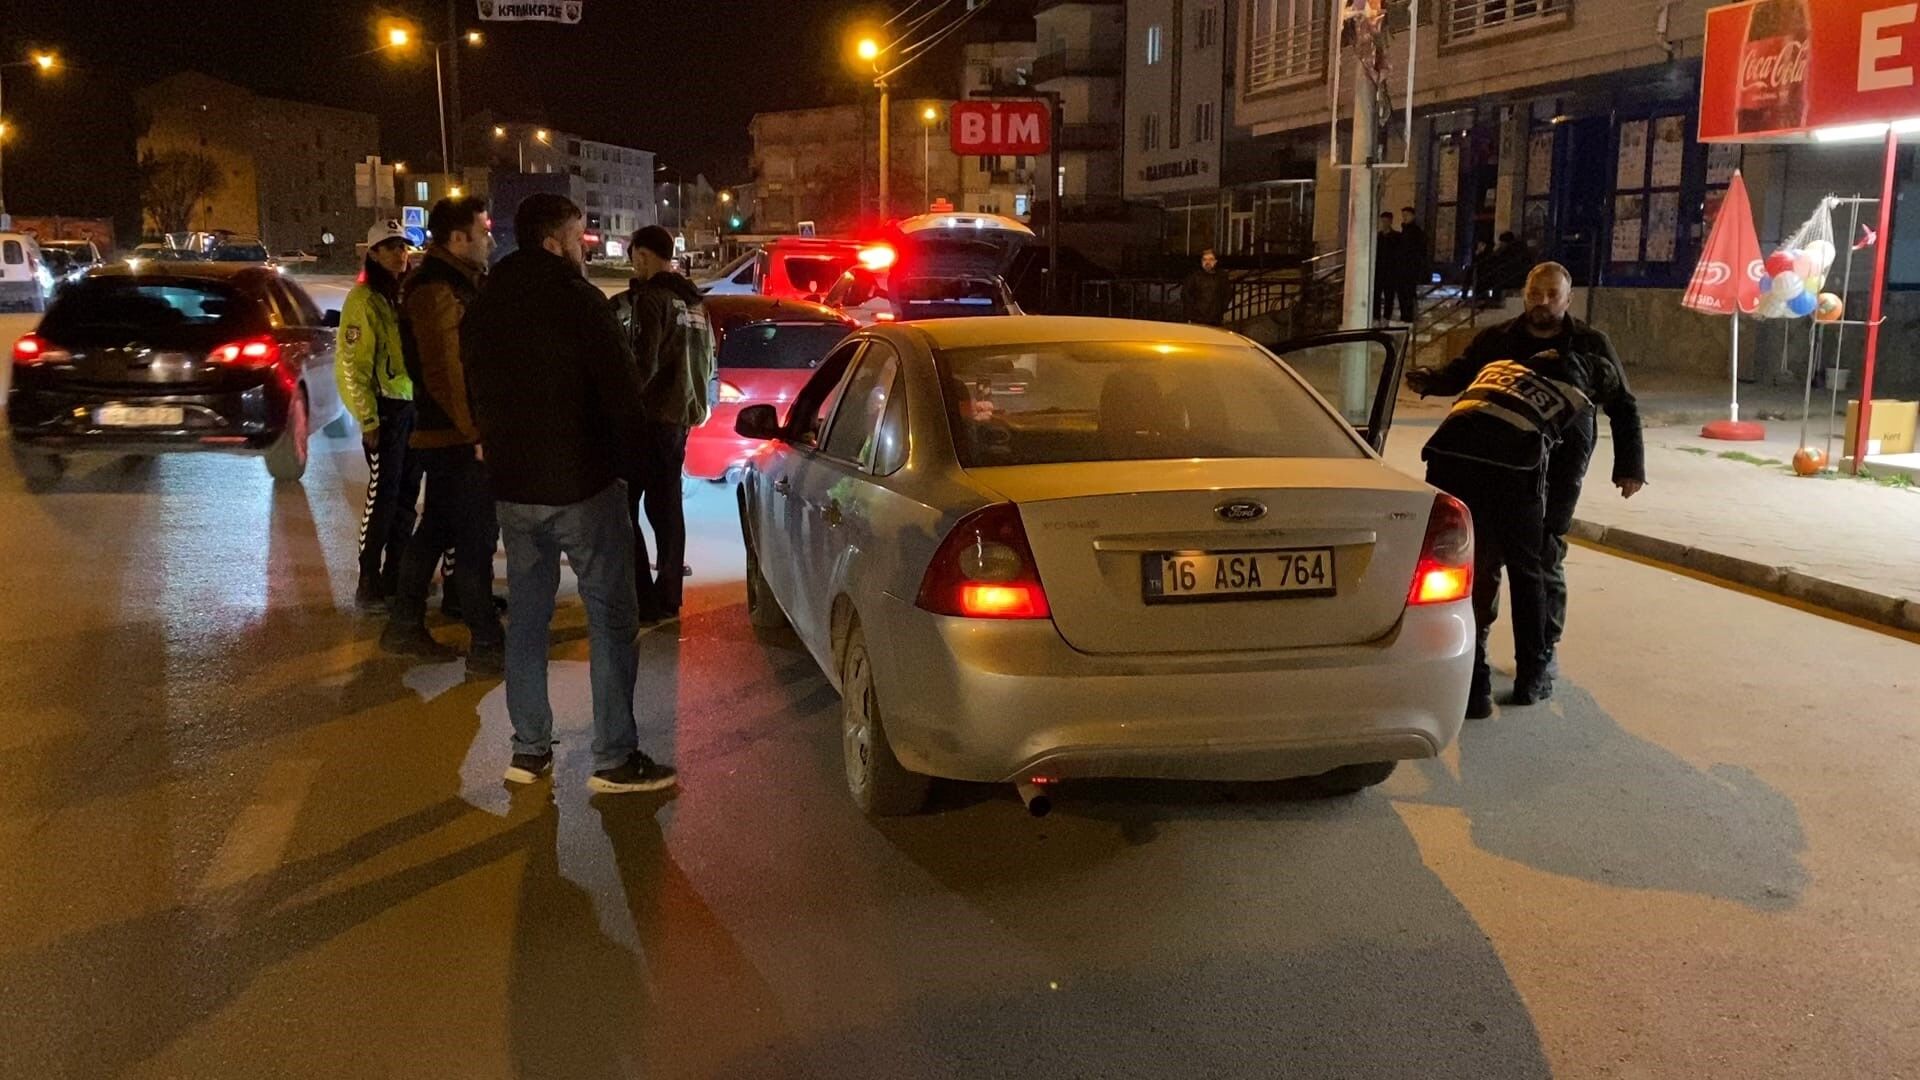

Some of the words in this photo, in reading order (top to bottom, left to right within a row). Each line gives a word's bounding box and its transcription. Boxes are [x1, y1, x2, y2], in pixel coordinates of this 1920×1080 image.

[1857, 3, 1918, 92] E
[961, 103, 1041, 144] BİM
[1168, 560, 1196, 591] 16
[1215, 557, 1261, 590] ASA
[1278, 554, 1324, 586] 764
